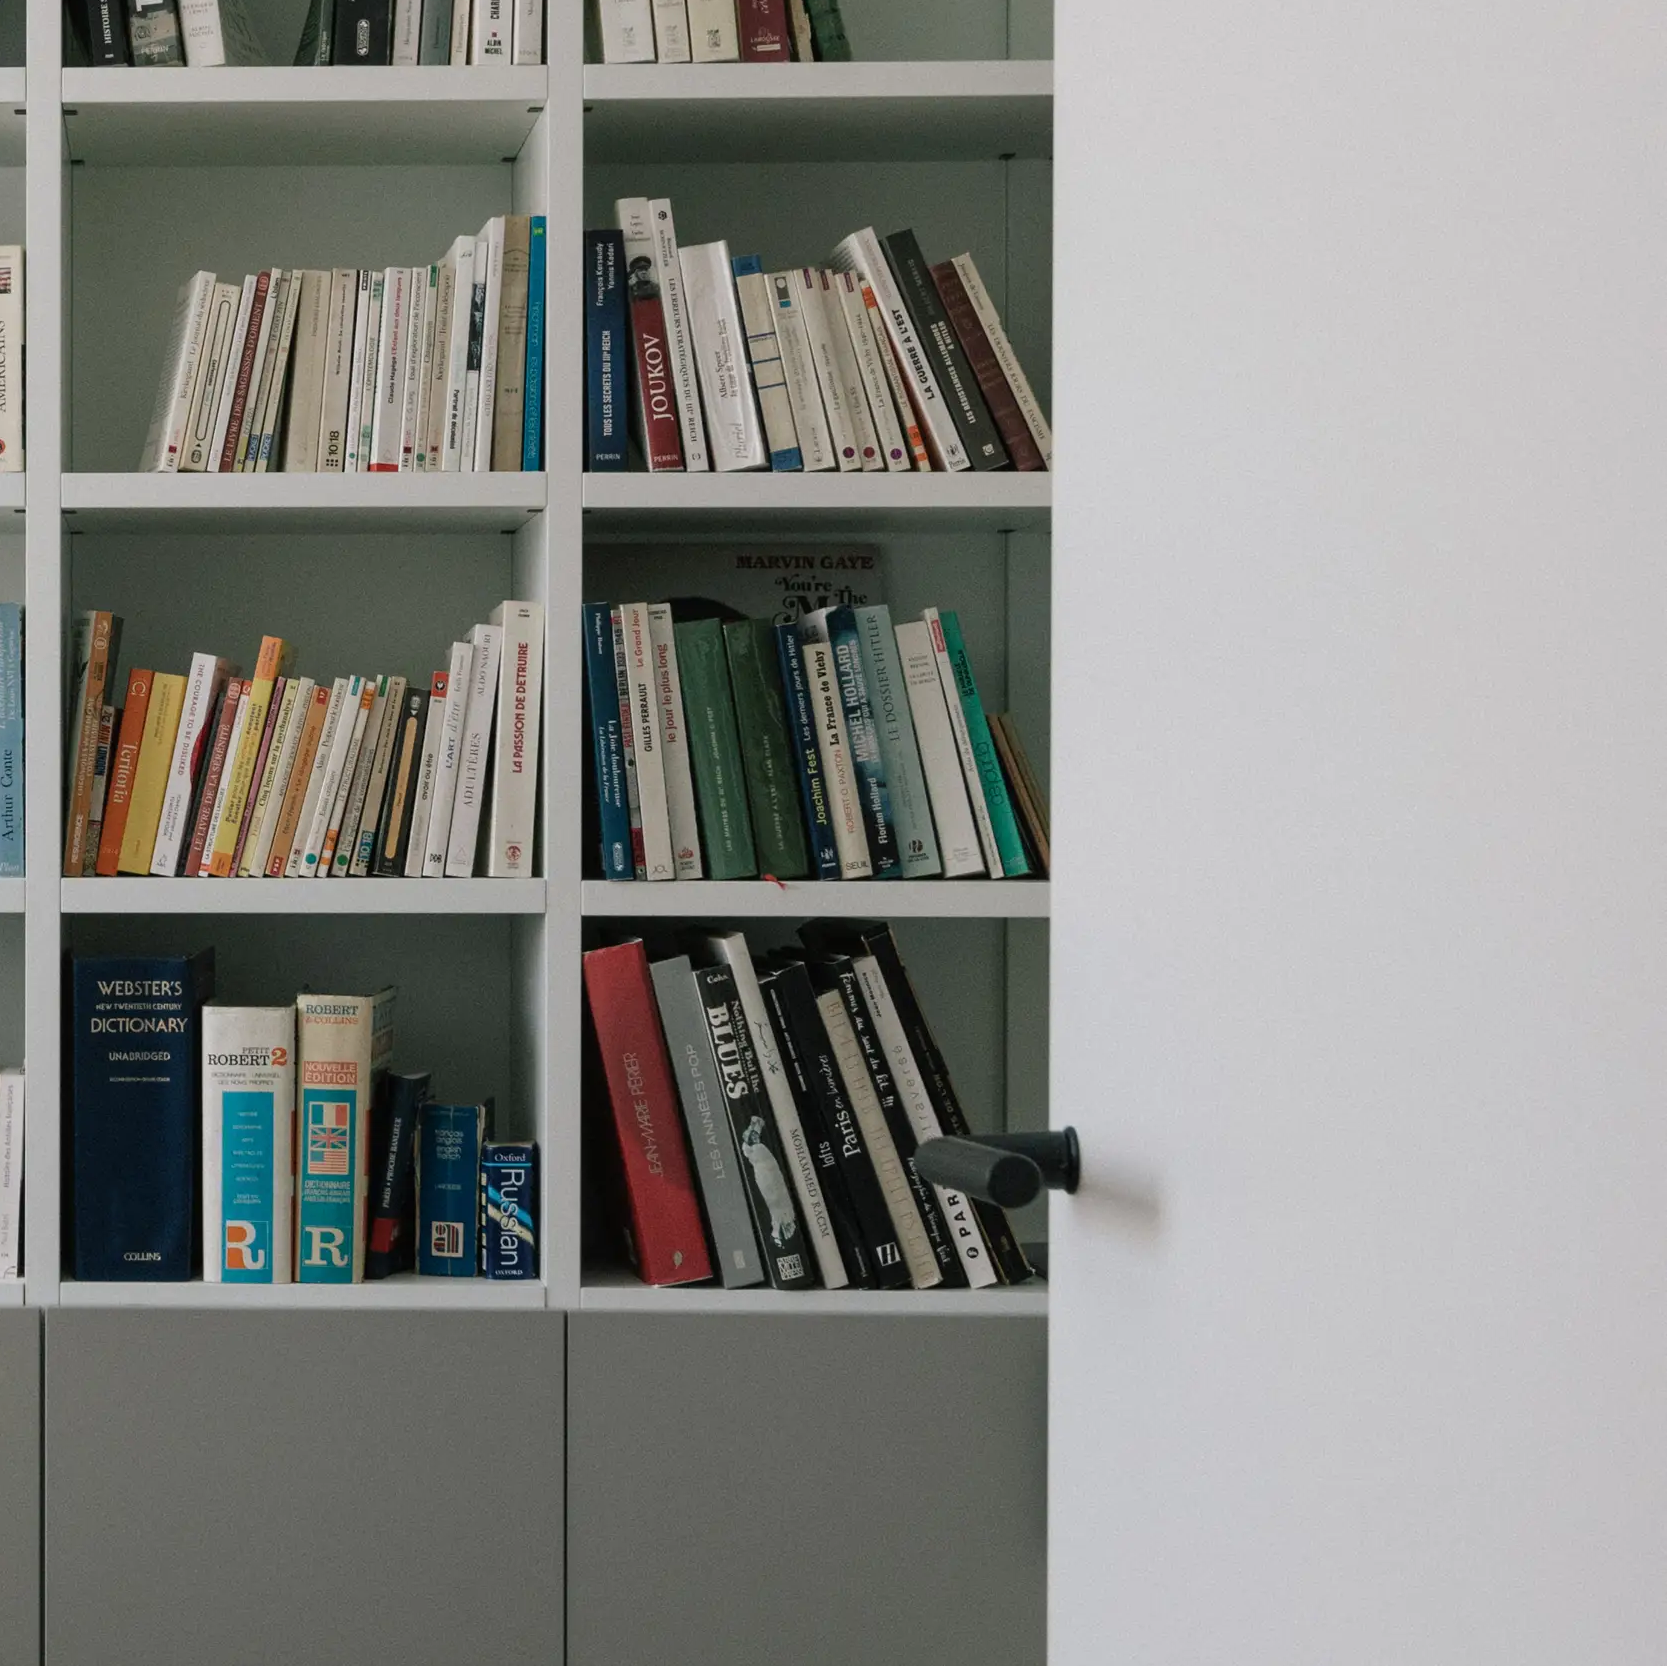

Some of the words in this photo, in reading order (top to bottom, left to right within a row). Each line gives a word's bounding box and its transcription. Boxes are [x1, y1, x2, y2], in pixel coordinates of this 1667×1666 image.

[243, 302, 264, 349] D'ORIENT
[892, 308, 909, 335] L'EST
[900, 335, 912, 344] À
[234, 351, 255, 397] SAGESSES
[907, 345, 929, 384] GUERRE
[642, 333, 674, 421] JOUKOV
[926, 385, 936, 401] LA
[229, 398, 242, 416] DES
[225, 421, 238, 446] LIVRE
[223, 449, 233, 462] LE
[736, 555, 817, 570] MARVIN
[820, 555, 875, 570] GAYE
[834, 585, 868, 606] The
[631, 609, 641, 629] Jour
[632, 631, 643, 658] Grand
[865, 614, 887, 663] HITLER
[634, 659, 644, 669] Le
[655, 644, 670, 669] long
[813, 650, 829, 679] Vichy
[658, 670, 673, 694] plus
[821, 680, 831, 693] de
[836, 644, 859, 707] HOLLARD
[514, 695, 526, 711] DE
[638, 683, 650, 724] PERRAULT
[661, 695, 672, 706] le
[875, 664, 897, 724] DOSSIER
[663, 708, 677, 731] jour
[823, 695, 839, 731] France
[512, 713, 525, 759] PASSION
[642, 725, 653, 753] GILLES
[666, 734, 677, 744] le
[828, 733, 840, 747] La
[849, 708, 868, 762] MICHEL
[888, 726, 900, 742] LE
[1, 749, 15, 789] Conte
[461, 733, 482, 808] ADULTÈRES
[511, 760, 522, 774] LA
[804, 749, 818, 775] Fest
[810, 778, 827, 825] Joachim
[1, 794, 15, 842] Arthur
[96, 980, 182, 997] WEBSTER'S
[95, 1002, 109, 1011] NEW
[110, 1002, 150, 1011] TWENTIETH
[151, 1002, 182, 1011] CENTURY
[305, 1004, 358, 1016] ROBERT
[90, 1016, 187, 1034] DICTIONARY
[305, 1016, 313, 1025] &
[313, 1016, 358, 1025] COLLINS
[108, 1051, 170, 1062] UNABRIDGED
[207, 1054, 270, 1066] ROBERT
[270, 1046, 287, 1067] 2
[241, 1046, 270, 1055] PETIT
[705, 1002, 750, 1100] BLUES
[304, 1063, 357, 1074] NOUVELLE
[305, 1071, 357, 1084] ÉDITION
[834, 1110, 861, 1158] Paris
[494, 1152, 526, 1163] Oxford
[817, 1141, 835, 1169] lofts
[789, 1127, 818, 1198] MOHAMMED
[809, 1200, 831, 1238] RACIM
[499, 1169, 525, 1266] Russian
[123, 1252, 161, 1261] COLLINS
[225, 1220, 265, 1270] R
[303, 1226, 348, 1267] R
